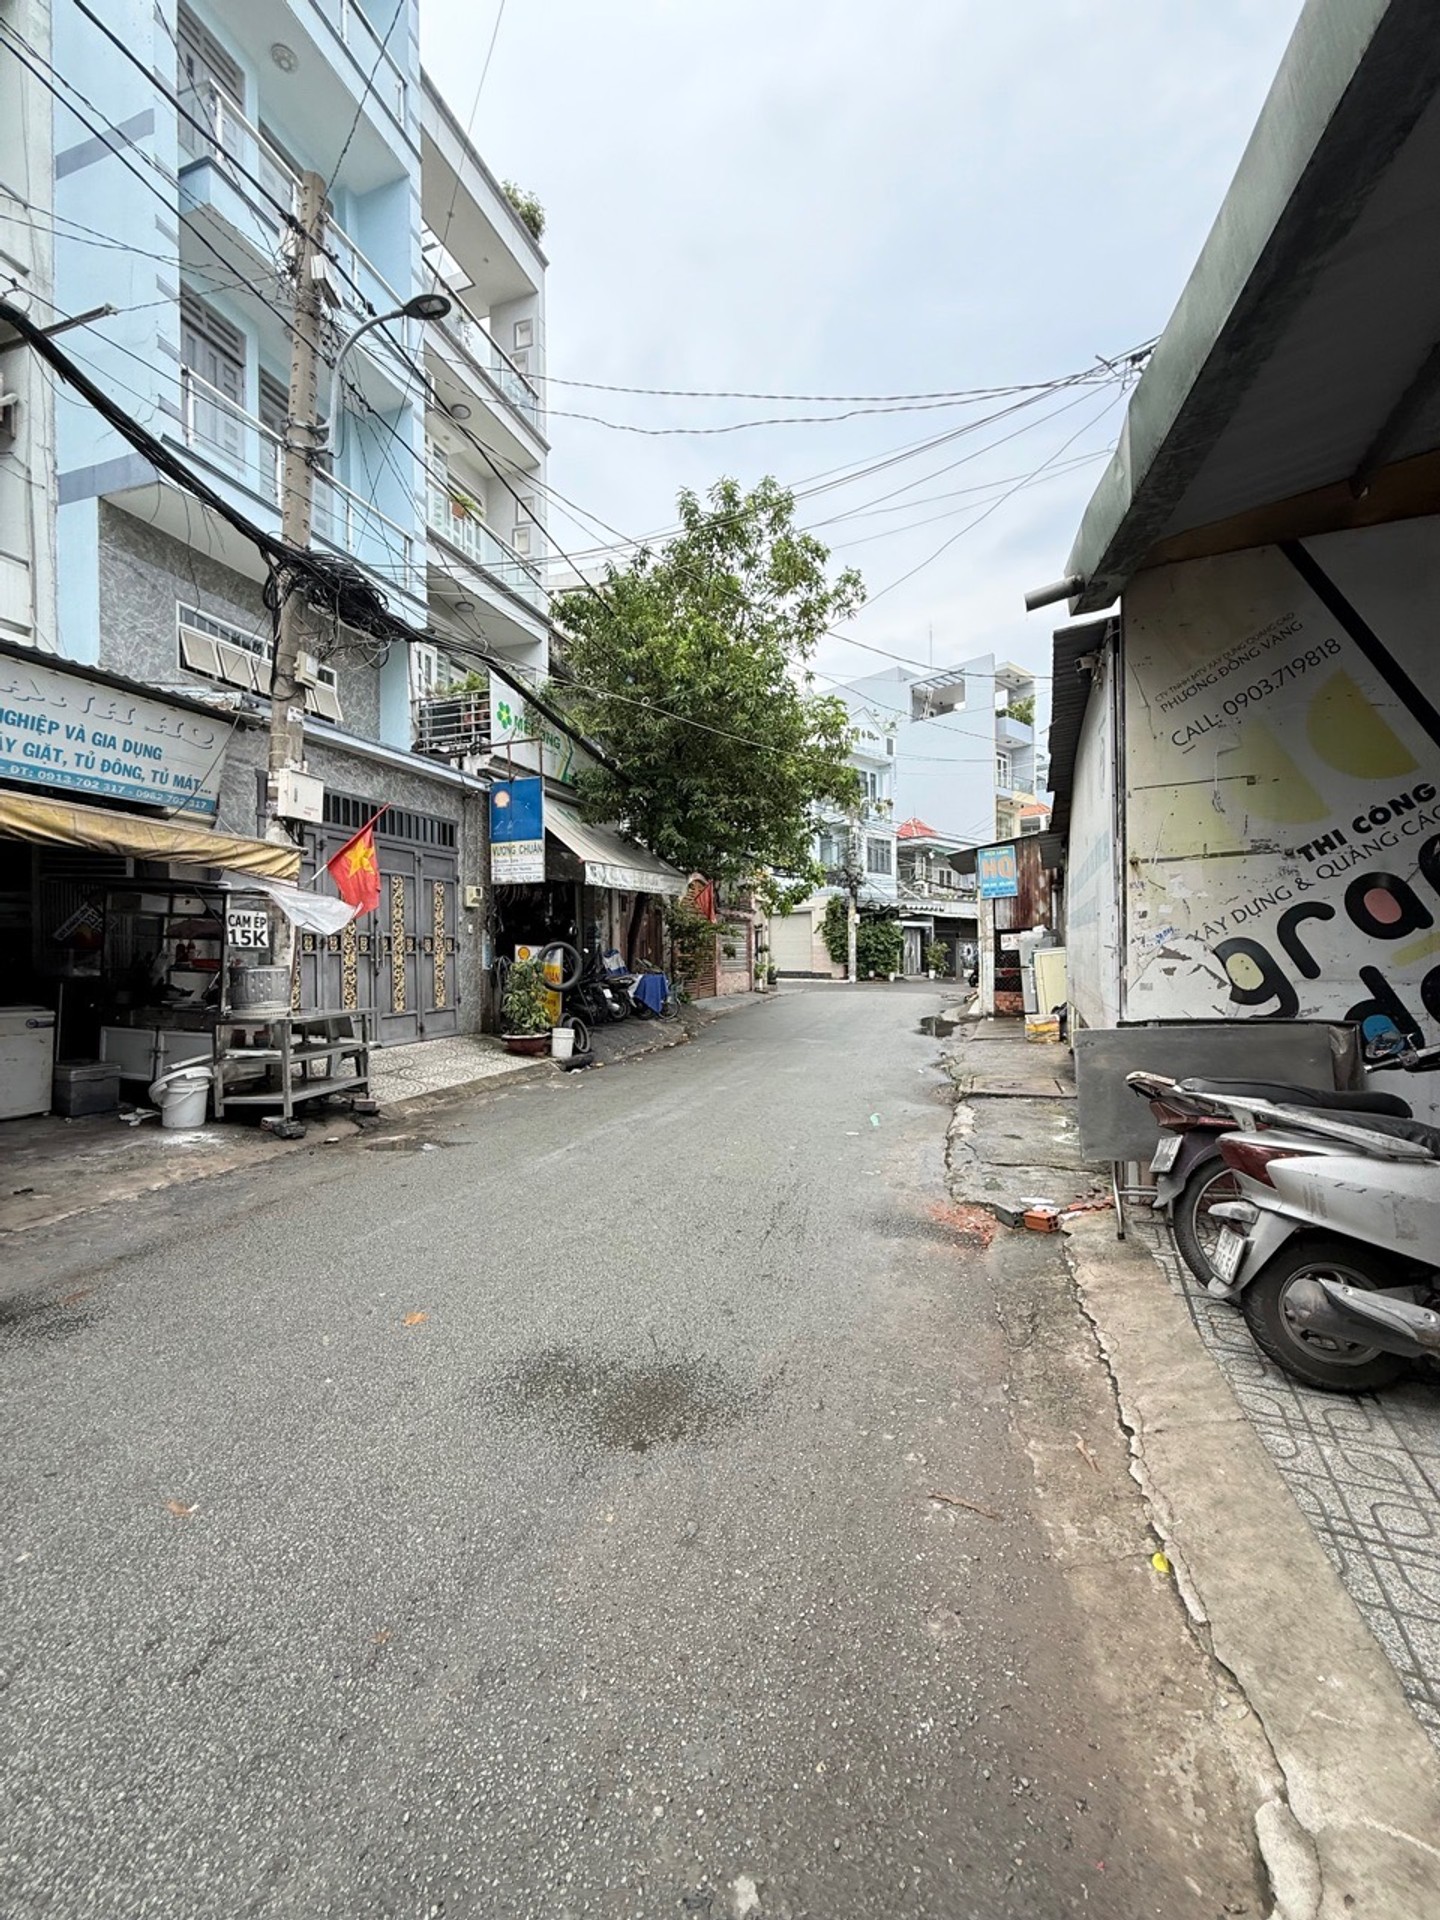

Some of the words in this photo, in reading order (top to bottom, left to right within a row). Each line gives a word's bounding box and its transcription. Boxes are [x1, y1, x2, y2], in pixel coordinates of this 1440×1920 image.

[1160, 673, 1219, 713] PHƯƠNG
[1171, 712, 1223, 748] CALL:
[1222, 637, 1342, 717] 0903.719818
[65, 721, 86, 743] VÀ
[91, 731, 117, 750] GIA
[122, 738, 163, 761] DỤNG
[22, 742, 68, 767] GIẶT,
[74, 750, 96, 770] TỦ
[100, 757, 145, 783] ĐÔNG,
[151, 767, 170, 786] TỦ
[1296, 829, 1349, 863] THI
[1351, 783, 1437, 835] CÔNG
[1231, 885, 1293, 925] DỰNG
[1297, 877, 1316, 892] &
[1316, 830, 1400, 882] QUẢNG
[228, 914, 252, 928] CAM
[253, 911, 267, 929] ÉP
[228, 928, 267, 946] 15K
